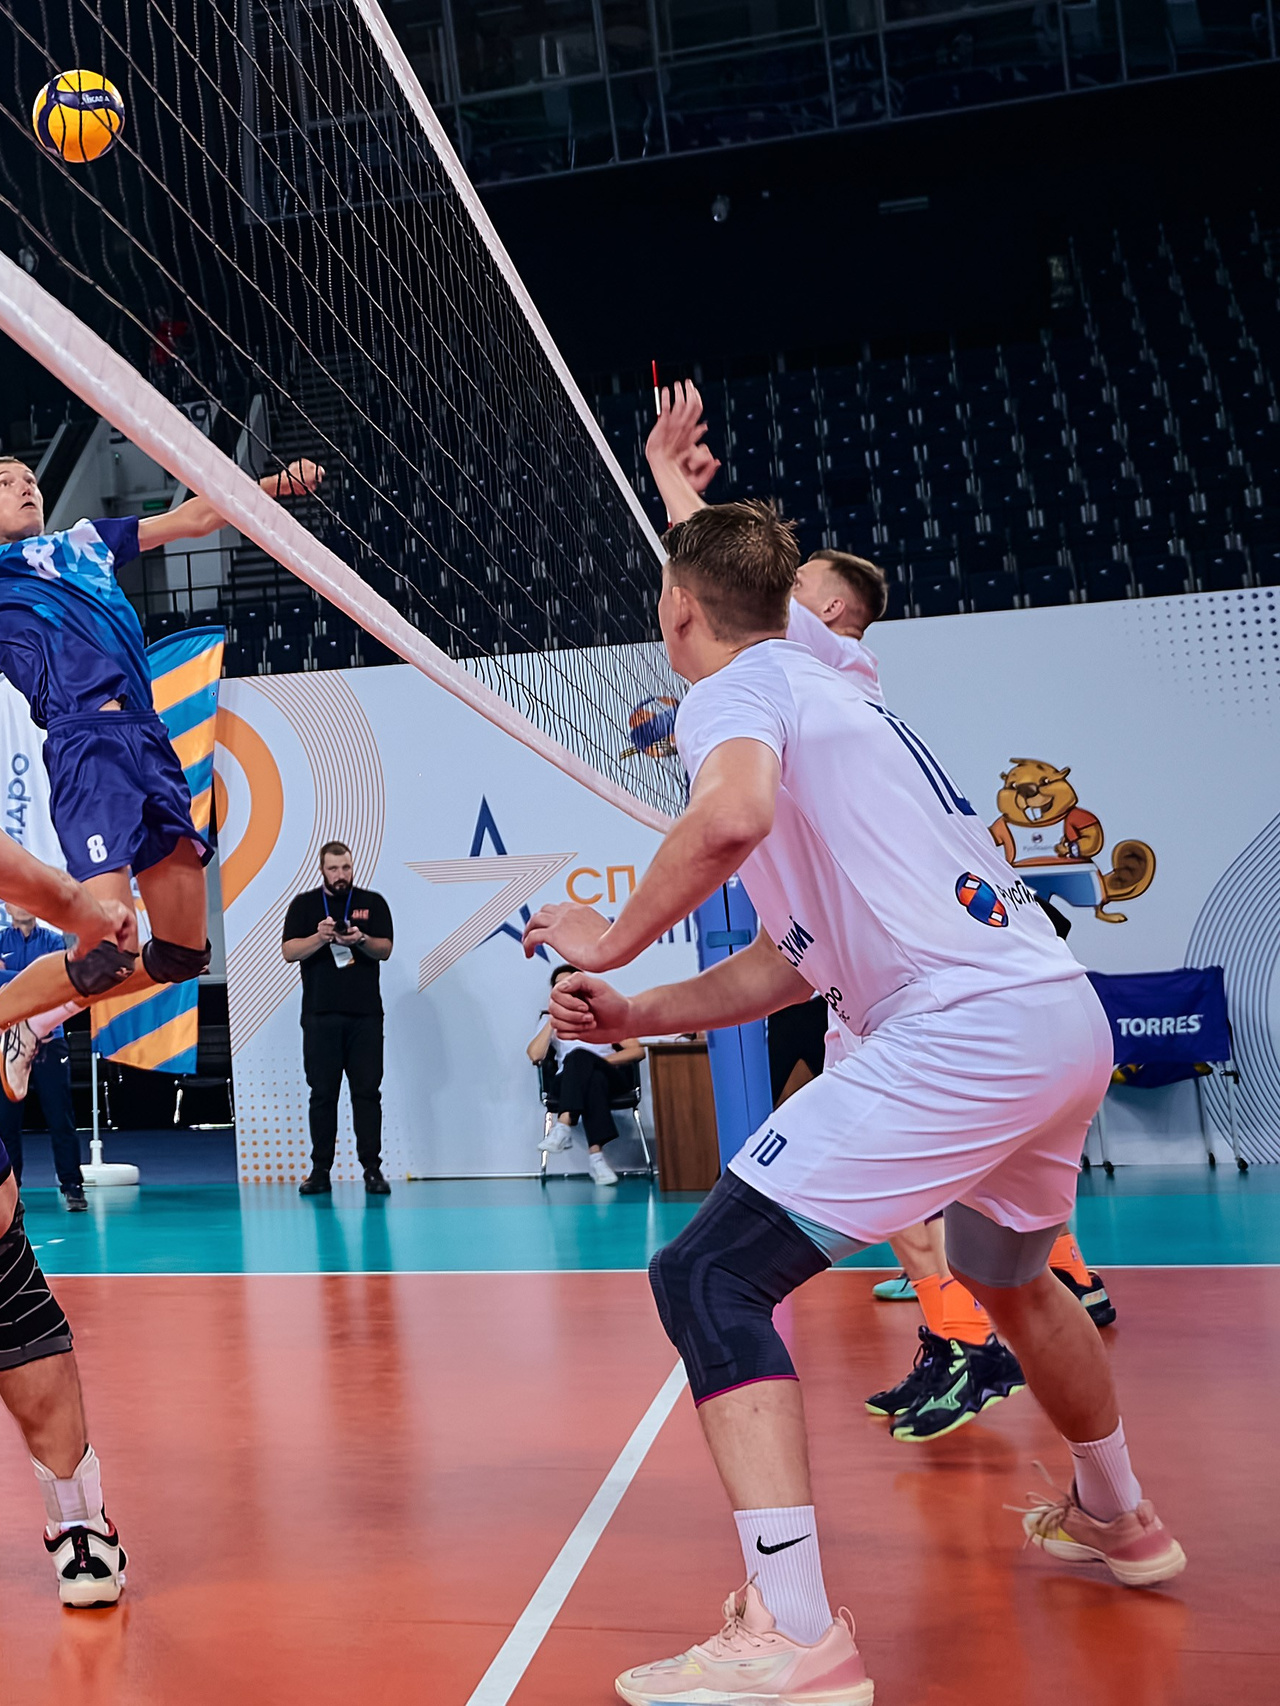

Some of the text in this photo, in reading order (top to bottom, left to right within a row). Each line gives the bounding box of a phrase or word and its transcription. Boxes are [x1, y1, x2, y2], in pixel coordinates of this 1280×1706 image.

[86, 834, 109, 864] 8
[1116, 1014, 1201, 1037] TORRES
[750, 1128, 788, 1167] 10
